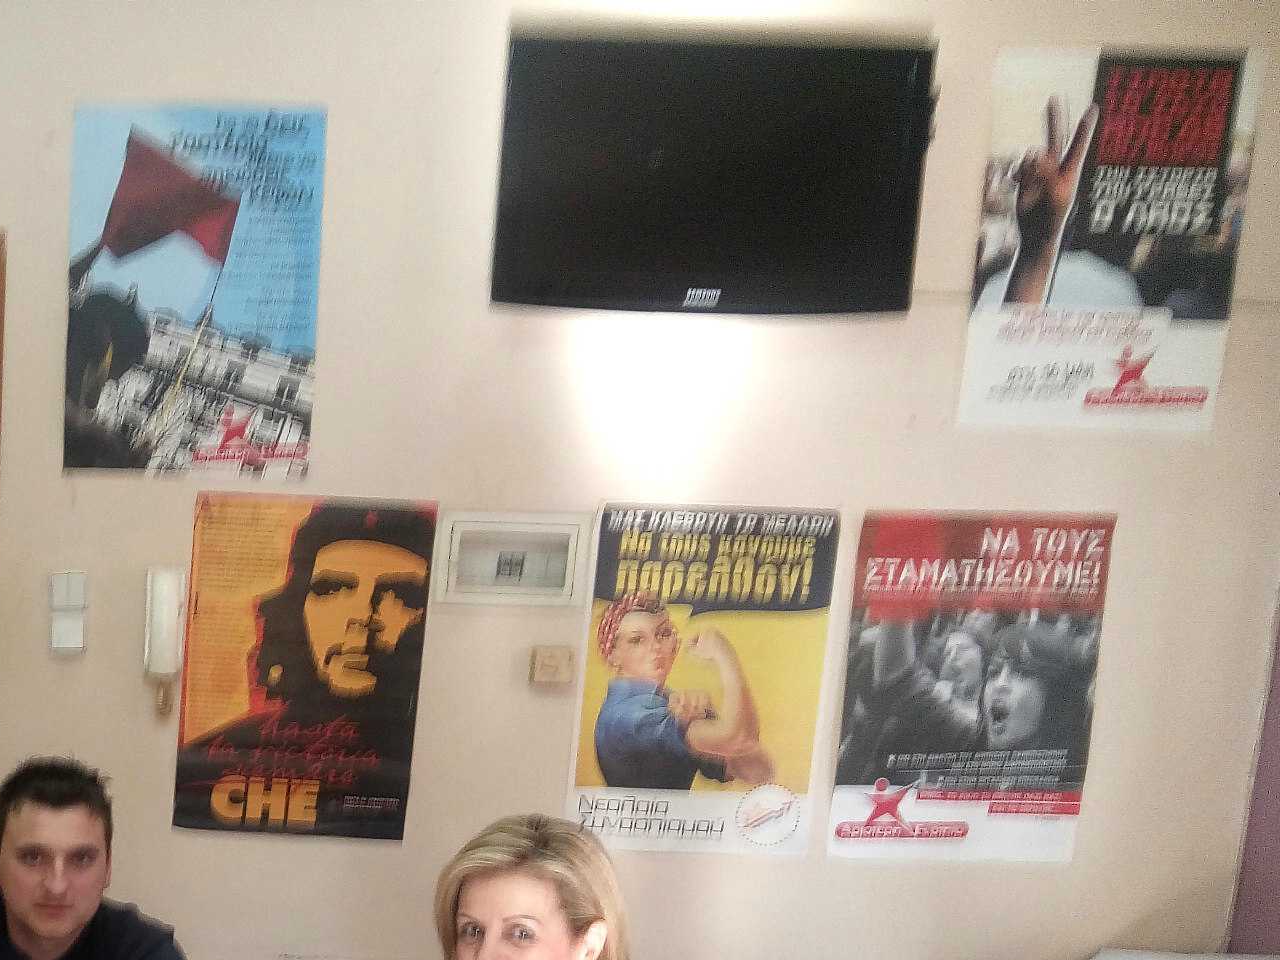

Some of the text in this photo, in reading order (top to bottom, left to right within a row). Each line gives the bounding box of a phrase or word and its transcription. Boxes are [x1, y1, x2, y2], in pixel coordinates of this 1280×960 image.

[1122, 200, 1215, 236] ΛΑΟΣ
[608, 510, 834, 537] ΜΑΣ ΚΛΕΒΟΥΝ ΤΟ ΜΕΛΛΟΝ
[981, 527, 1106, 561] ΝΑ ΤΟΥΣ
[865, 557, 1102, 592] ΣΤΑΜΑΤΗΣΟΥΜΕ!
[210, 774, 321, 826] CHE
